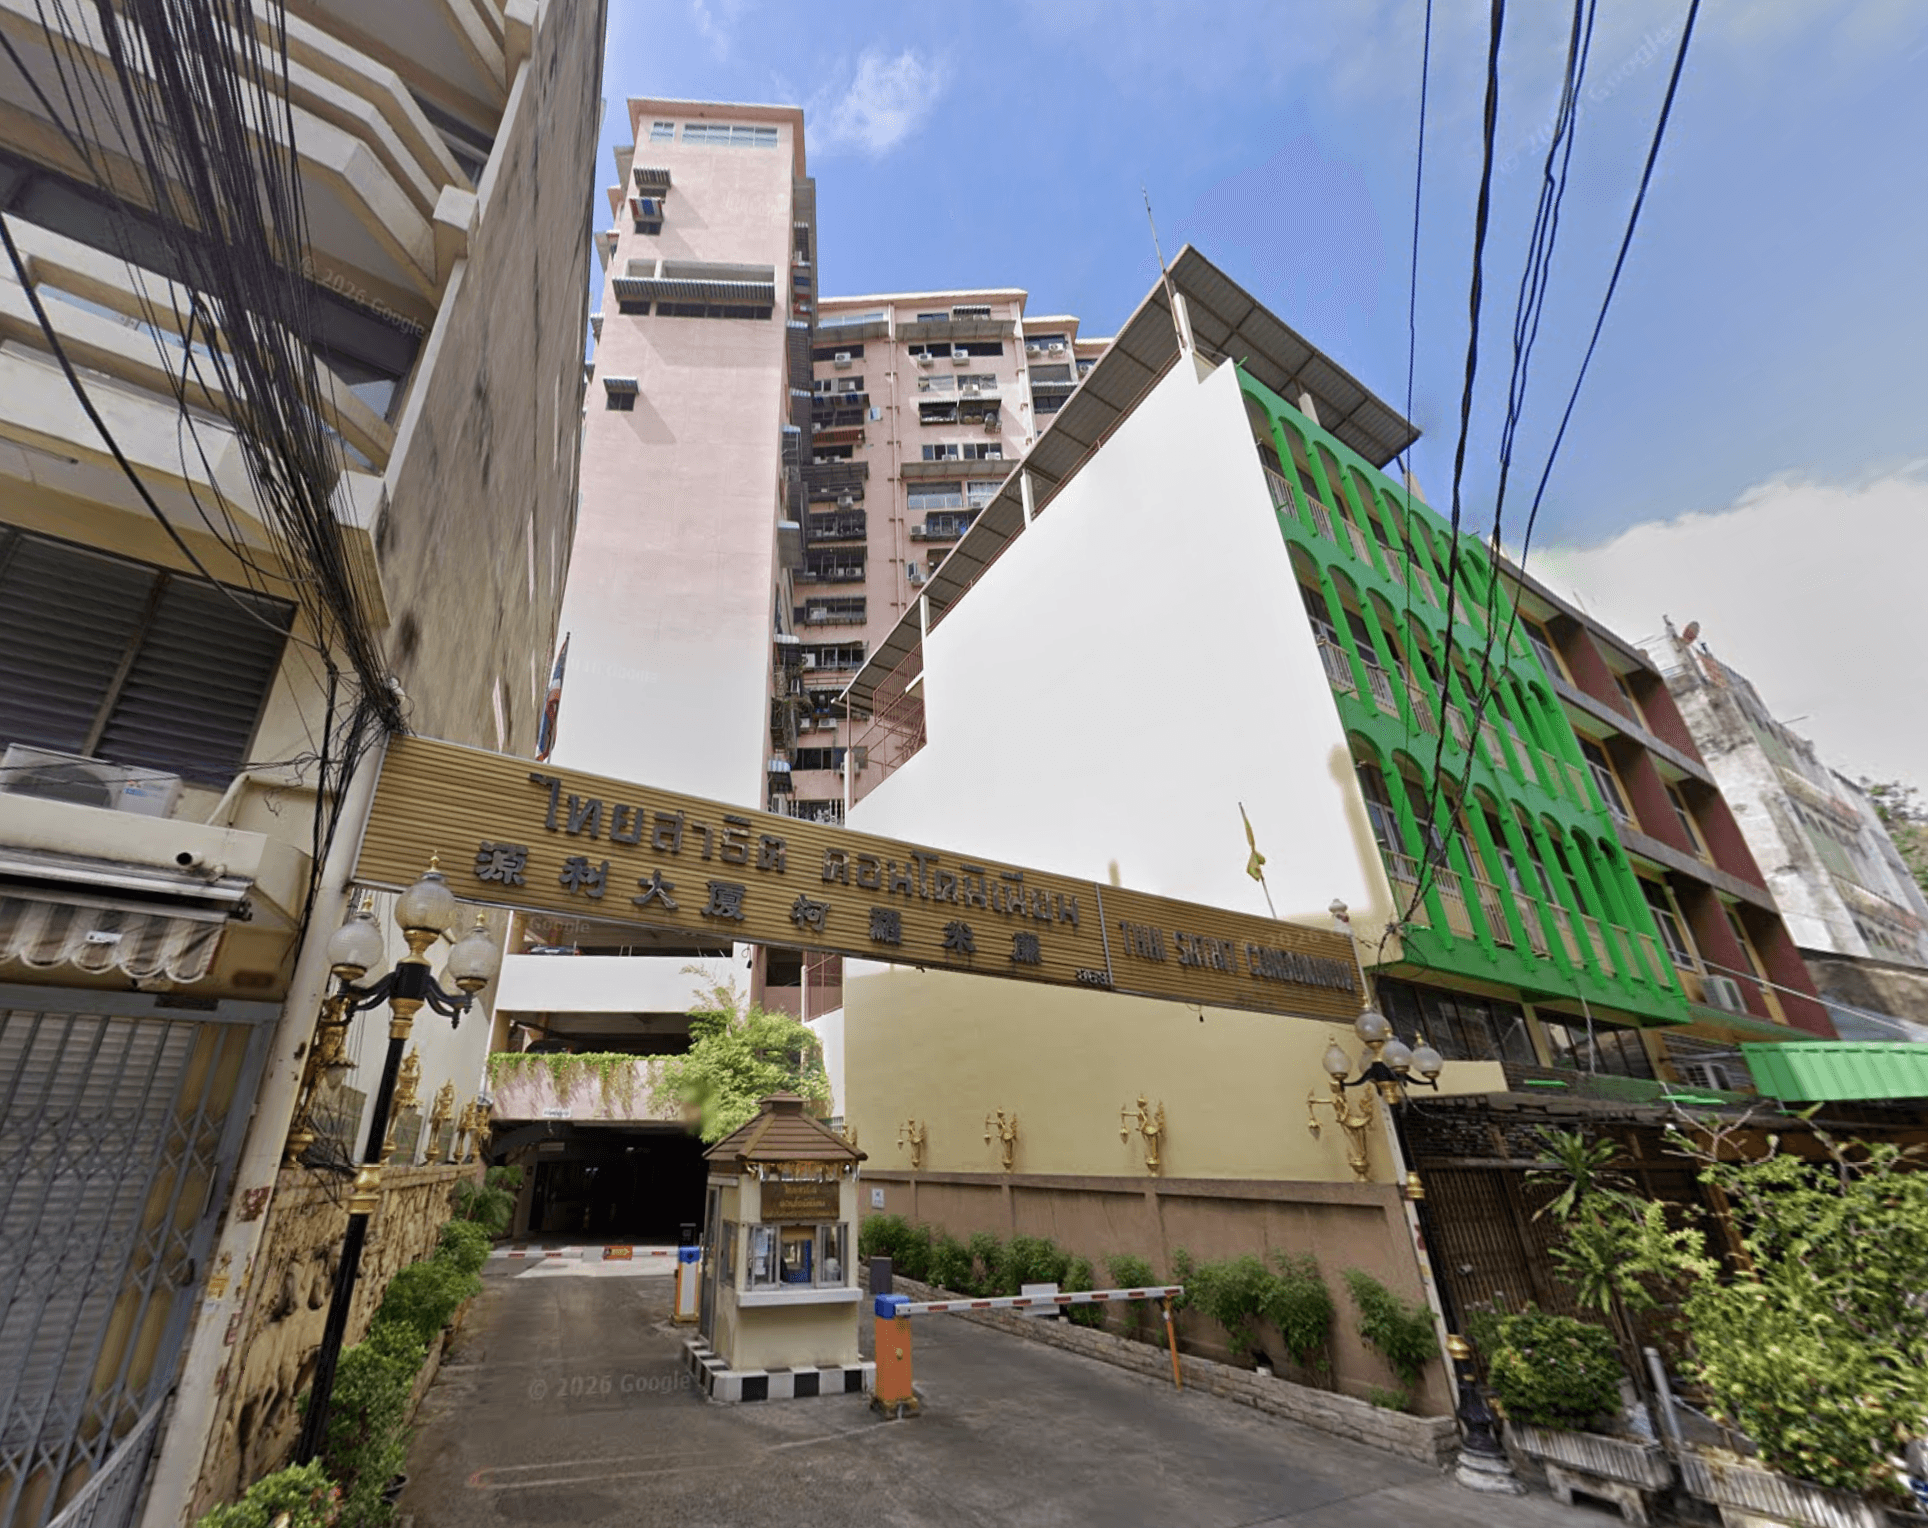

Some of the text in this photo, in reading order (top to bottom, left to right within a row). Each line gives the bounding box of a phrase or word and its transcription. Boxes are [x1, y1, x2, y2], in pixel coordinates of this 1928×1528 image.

[822, 847, 1079, 926] คอนโดมิเนียม
[1119, 920, 1168, 962] THAI
